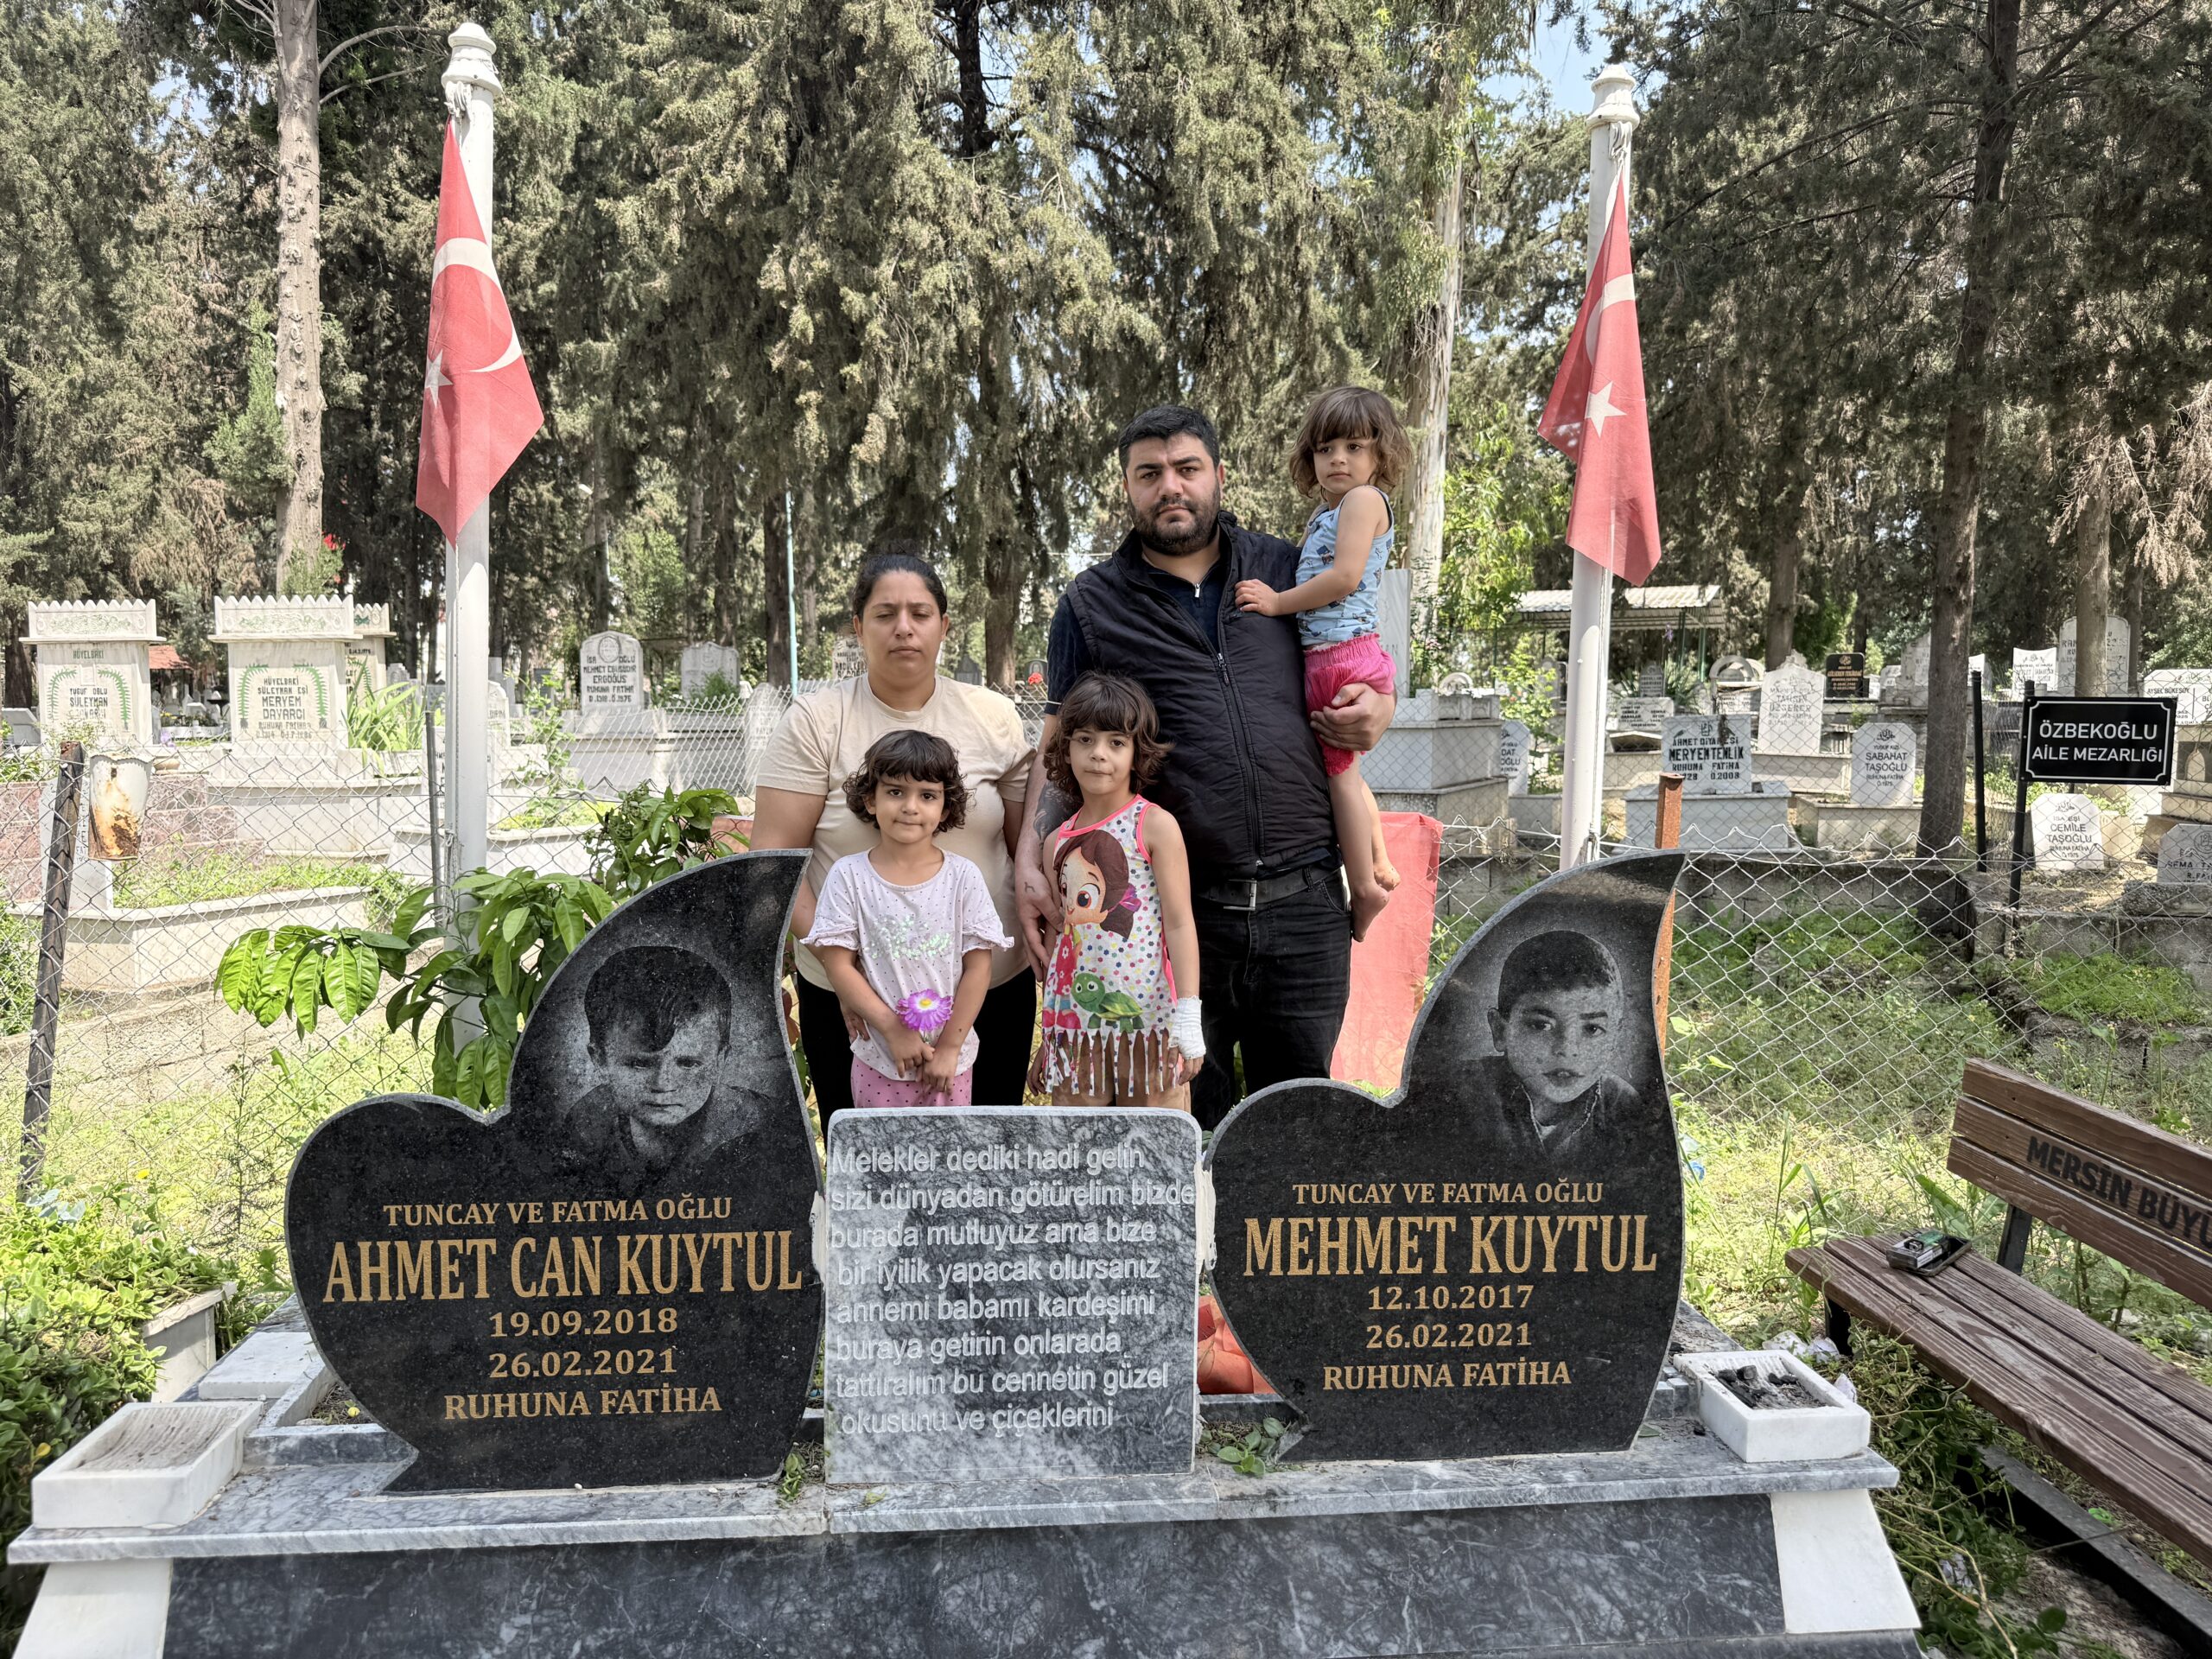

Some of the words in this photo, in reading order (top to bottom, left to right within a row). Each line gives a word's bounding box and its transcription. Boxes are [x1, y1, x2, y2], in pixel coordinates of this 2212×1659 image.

[69, 696, 108, 708] SÜLEYMAN
[257, 685, 293, 695] SÜLEYMAN
[262, 696, 302, 707] MERYEM
[2039, 719, 2158, 740] ÖZBEKOĞLU
[1501, 757, 1521, 766] OĞLU
[1672, 763, 1703, 772] RUHUNA
[1712, 761, 1739, 770] FATİHA
[1866, 752, 1908, 760] SABAHAT
[1866, 762, 1908, 773] TAŞOĞLU
[2032, 744, 2069, 760] AİLE
[2074, 747, 2163, 762] MEZARLIĞI
[2047, 834, 2092, 844] TAŞOĞLU
[2050, 823, 2087, 832] CEMİLE
[833, 1145, 940, 1173] Melekler
[947, 1144, 1020, 1171] dediki
[1028, 1143, 1080, 1170] hadi
[1086, 1142, 1144, 1175] gelin
[2026, 1135, 2133, 1207] MERSİN
[831, 1184, 872, 1211] sizi
[880, 1182, 1003, 1215] dünyadan
[1011, 1179, 1123, 1214] götürelim
[1132, 1178, 1195, 1206] bizde
[1292, 1183, 1396, 1205] TUNCAY
[1402, 1183, 1435, 1205] VE
[1442, 1181, 1529, 1204] FATMA
[1535, 1178, 1604, 1204] OĞLU
[383, 1203, 499, 1227] TUNCAY
[505, 1202, 543, 1224] VE
[552, 1199, 648, 1223] FATMA
[656, 1192, 732, 1220] OĞLU
[831, 1220, 919, 1248] burada
[927, 1218, 1039, 1251] mutluyuz
[1046, 1222, 1100, 1243] ama
[1107, 1216, 1157, 1243] bize
[1243, 1215, 1457, 1276] MEHMET
[1468, 1214, 1657, 1274] KUYTUL
[322, 1237, 497, 1302] AHMET
[510, 1236, 602, 1298] CAN
[617, 1230, 804, 1296] KUYTUL
[838, 1258, 870, 1286] bir
[878, 1257, 931, 1291] iyilik
[938, 1255, 1042, 1290] yapacak
[1049, 1253, 1161, 1281] olursanız
[837, 1296, 929, 1323] annemi
[938, 1294, 1030, 1320] babamı
[1039, 1288, 1155, 1324] kardeşimi
[1367, 1285, 1535, 1310] 12.10.2017
[489, 1307, 678, 1338] 19.09.2018
[1366, 1323, 1532, 1349] 26.02.2021
[836, 1334, 922, 1365] buraya
[930, 1330, 1006, 1364] getirin
[1014, 1326, 1122, 1356] onlarada
[489, 1347, 677, 1379] 26.02.2021
[953, 1368, 984, 1394] bu
[992, 1363, 1096, 1393] cennetin
[1103, 1361, 1169, 1396] güzel
[1323, 1365, 1455, 1391] RUHUNA
[1463, 1357, 1572, 1387] FATİHA
[444, 1391, 591, 1421] RUHUNA
[600, 1382, 722, 1415] FATİHA
[955, 1409, 986, 1430] ve
[992, 1400, 1114, 1438] çiçeklerini
